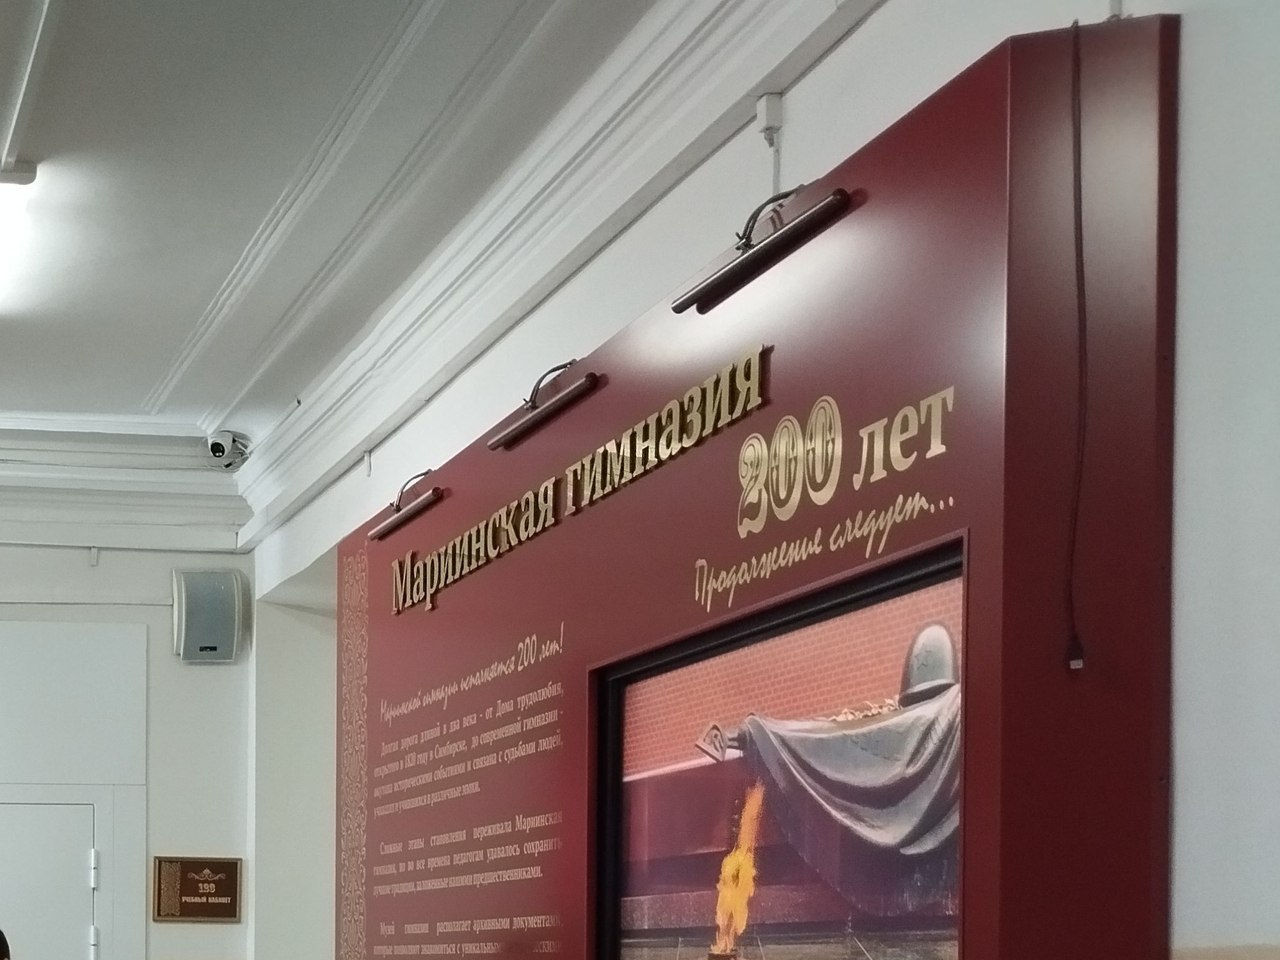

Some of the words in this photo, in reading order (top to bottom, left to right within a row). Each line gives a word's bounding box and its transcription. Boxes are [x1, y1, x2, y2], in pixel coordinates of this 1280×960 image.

[392, 477, 556, 614] Мариинская
[564, 344, 764, 517] гимназия
[738, 395, 842, 539] 200
[853, 385, 954, 490] лет
[695, 527, 822, 613] Продолжение
[829, 492, 954, 558] следует...
[517, 633, 537, 671] 200
[463, 713, 477, 728] века
[485, 708, 492, 719] от
[496, 699, 513, 717] Дома
[517, 681, 564, 711] трудолюбия,
[480, 716, 521, 745] современной
[523, 708, 558, 731] гимназии
[473, 752, 497, 770] связана
[498, 751, 502, 763] с
[504, 739, 536, 764] судьбами
[473, 820, 512, 840] переживала
[515, 810, 562, 832] Мариинская
[486, 843, 520, 863] удавалось
